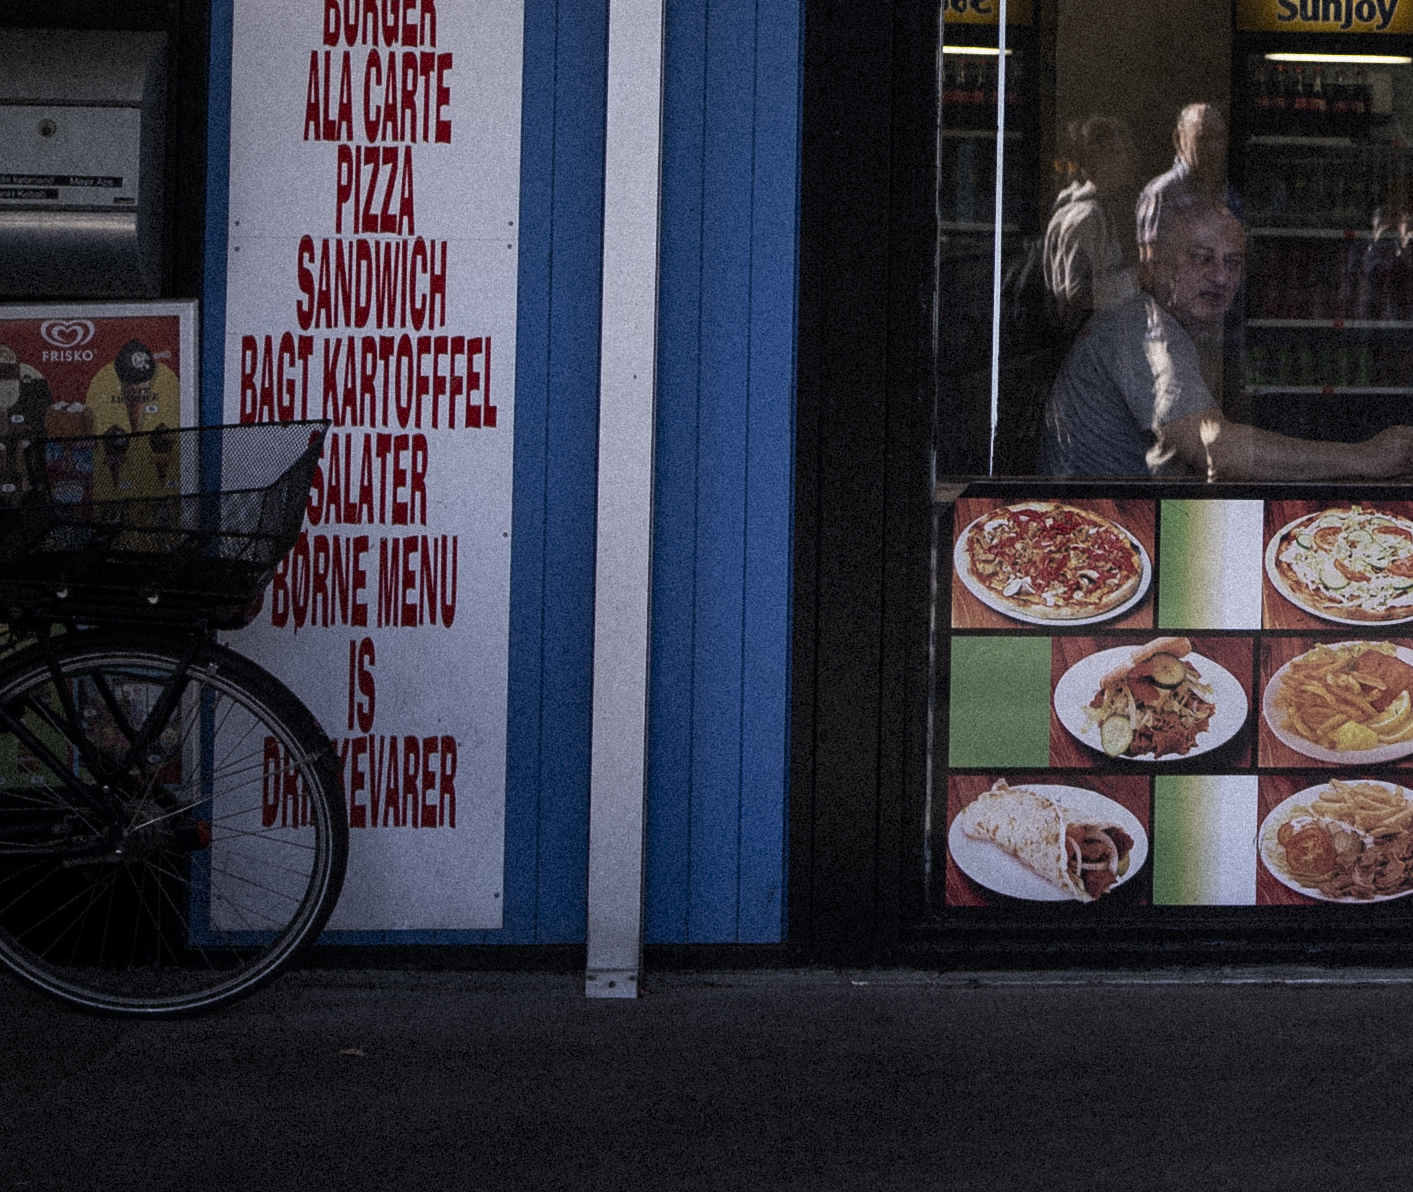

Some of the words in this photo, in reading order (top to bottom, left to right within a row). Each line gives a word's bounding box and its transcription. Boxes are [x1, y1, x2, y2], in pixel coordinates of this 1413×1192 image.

[303, 50, 353, 142] ALA
[363, 49, 453, 144] CARTE
[336, 144, 415, 235] PIZZA
[296, 235, 448, 331] SANDWICH
[42, 349, 94, 362] FRISKO
[240, 331, 313, 427] BAGT
[323, 334, 497, 429] KARTOFFFEL
[271, 529, 368, 635] BØRNE
[377, 535, 458, 628] MENU
[348, 637, 375, 734] IS
